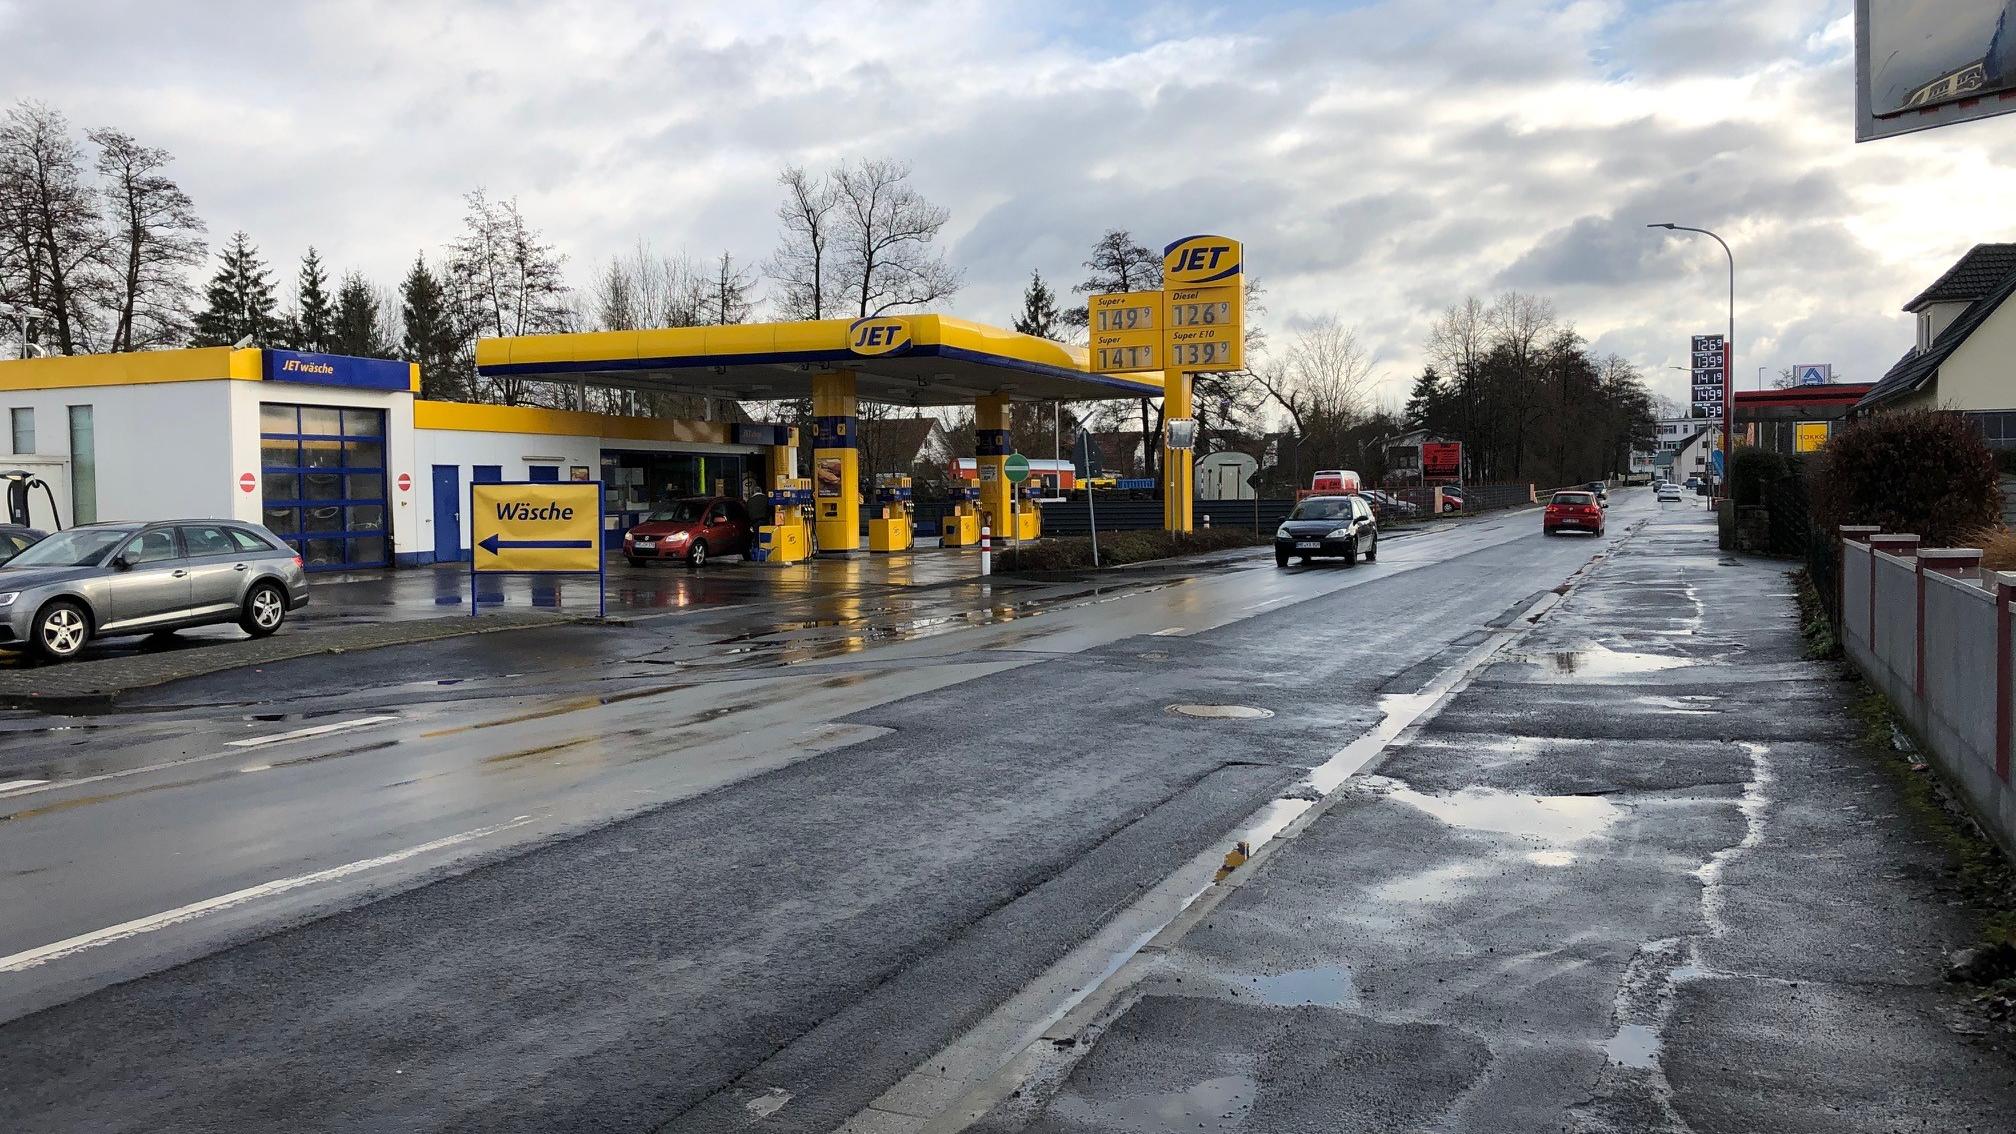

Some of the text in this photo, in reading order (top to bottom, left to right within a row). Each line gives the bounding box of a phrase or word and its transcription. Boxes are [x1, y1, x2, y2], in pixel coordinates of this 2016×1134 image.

[1171, 247, 1230, 272] JET
[1173, 291, 1198, 300] Diesel
[1098, 298, 1125, 307] Super+
[855, 326, 902, 346] JET
[1173, 330, 1214, 340] Super E10
[1098, 336, 1121, 345] Super
[497, 501, 574, 520] Wäsche
